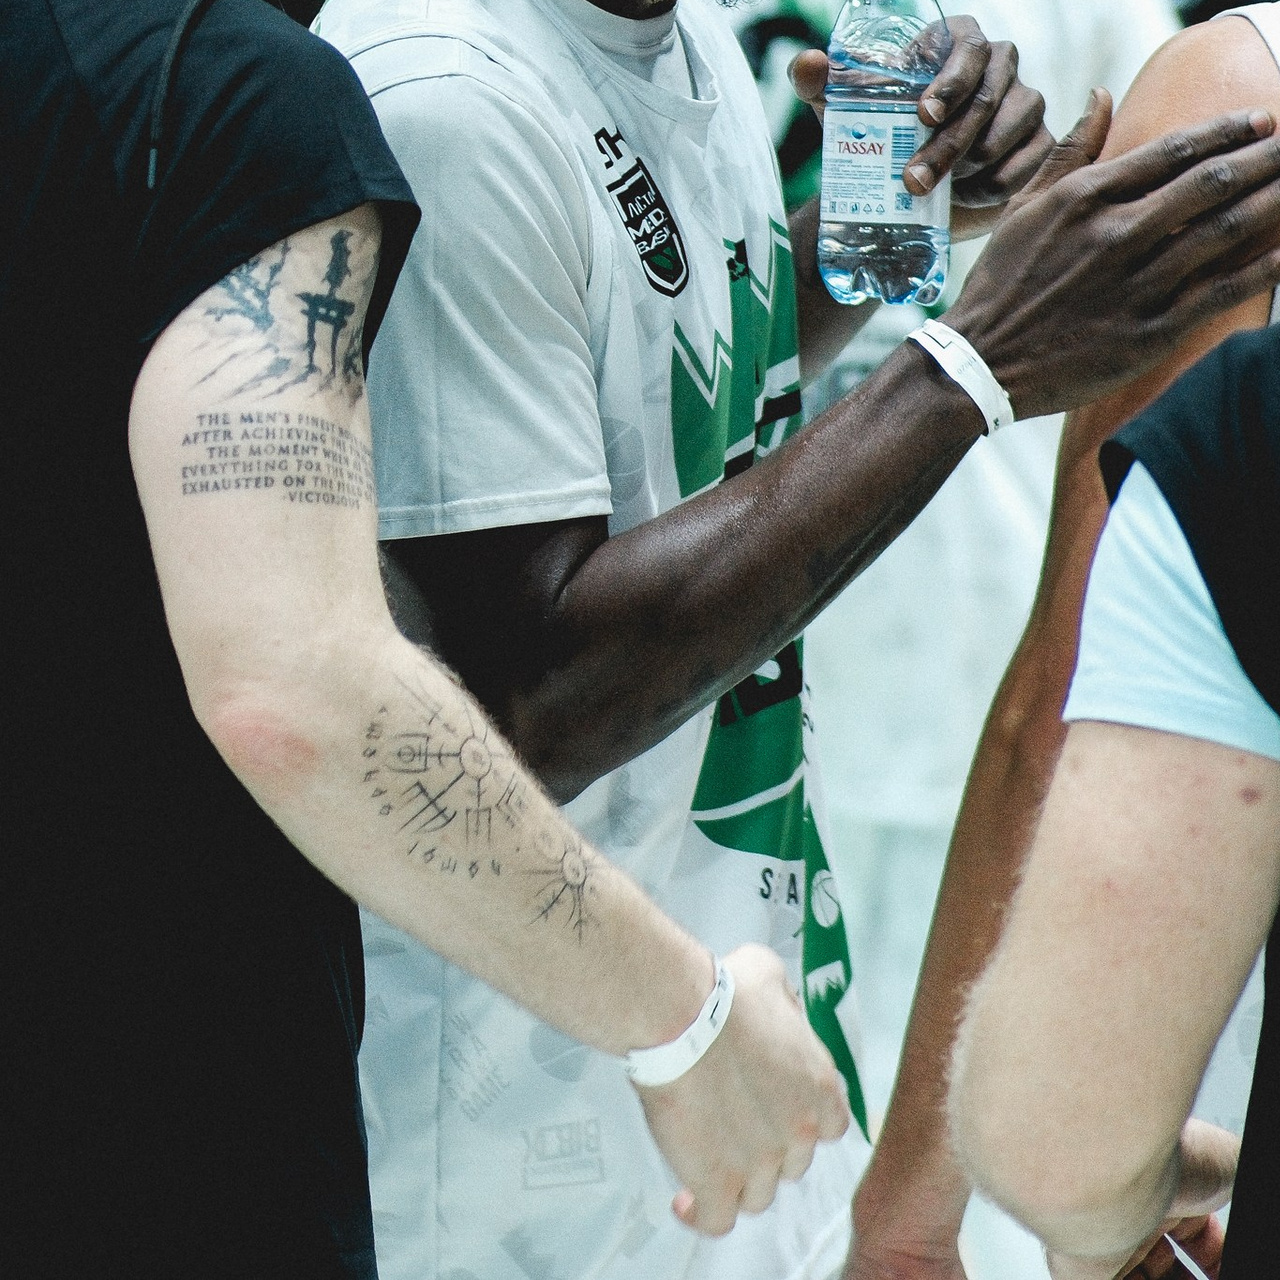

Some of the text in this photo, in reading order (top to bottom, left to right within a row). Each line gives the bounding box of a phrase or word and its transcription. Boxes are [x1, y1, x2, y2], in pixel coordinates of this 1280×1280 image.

[837, 141, 886, 156] TASSAY
[196, 412, 231, 427] THE
[182, 428, 234, 447] AFTER
[240, 427, 327, 445] ACHIEVING
[206, 444, 242, 460] THE
[248, 443, 319, 457] MOMENT
[181, 458, 289, 480] EVERYTHING
[295, 458, 322, 472] FOR
[181, 475, 276, 497] EXHAUSTED
[282, 475, 307, 488] ON
